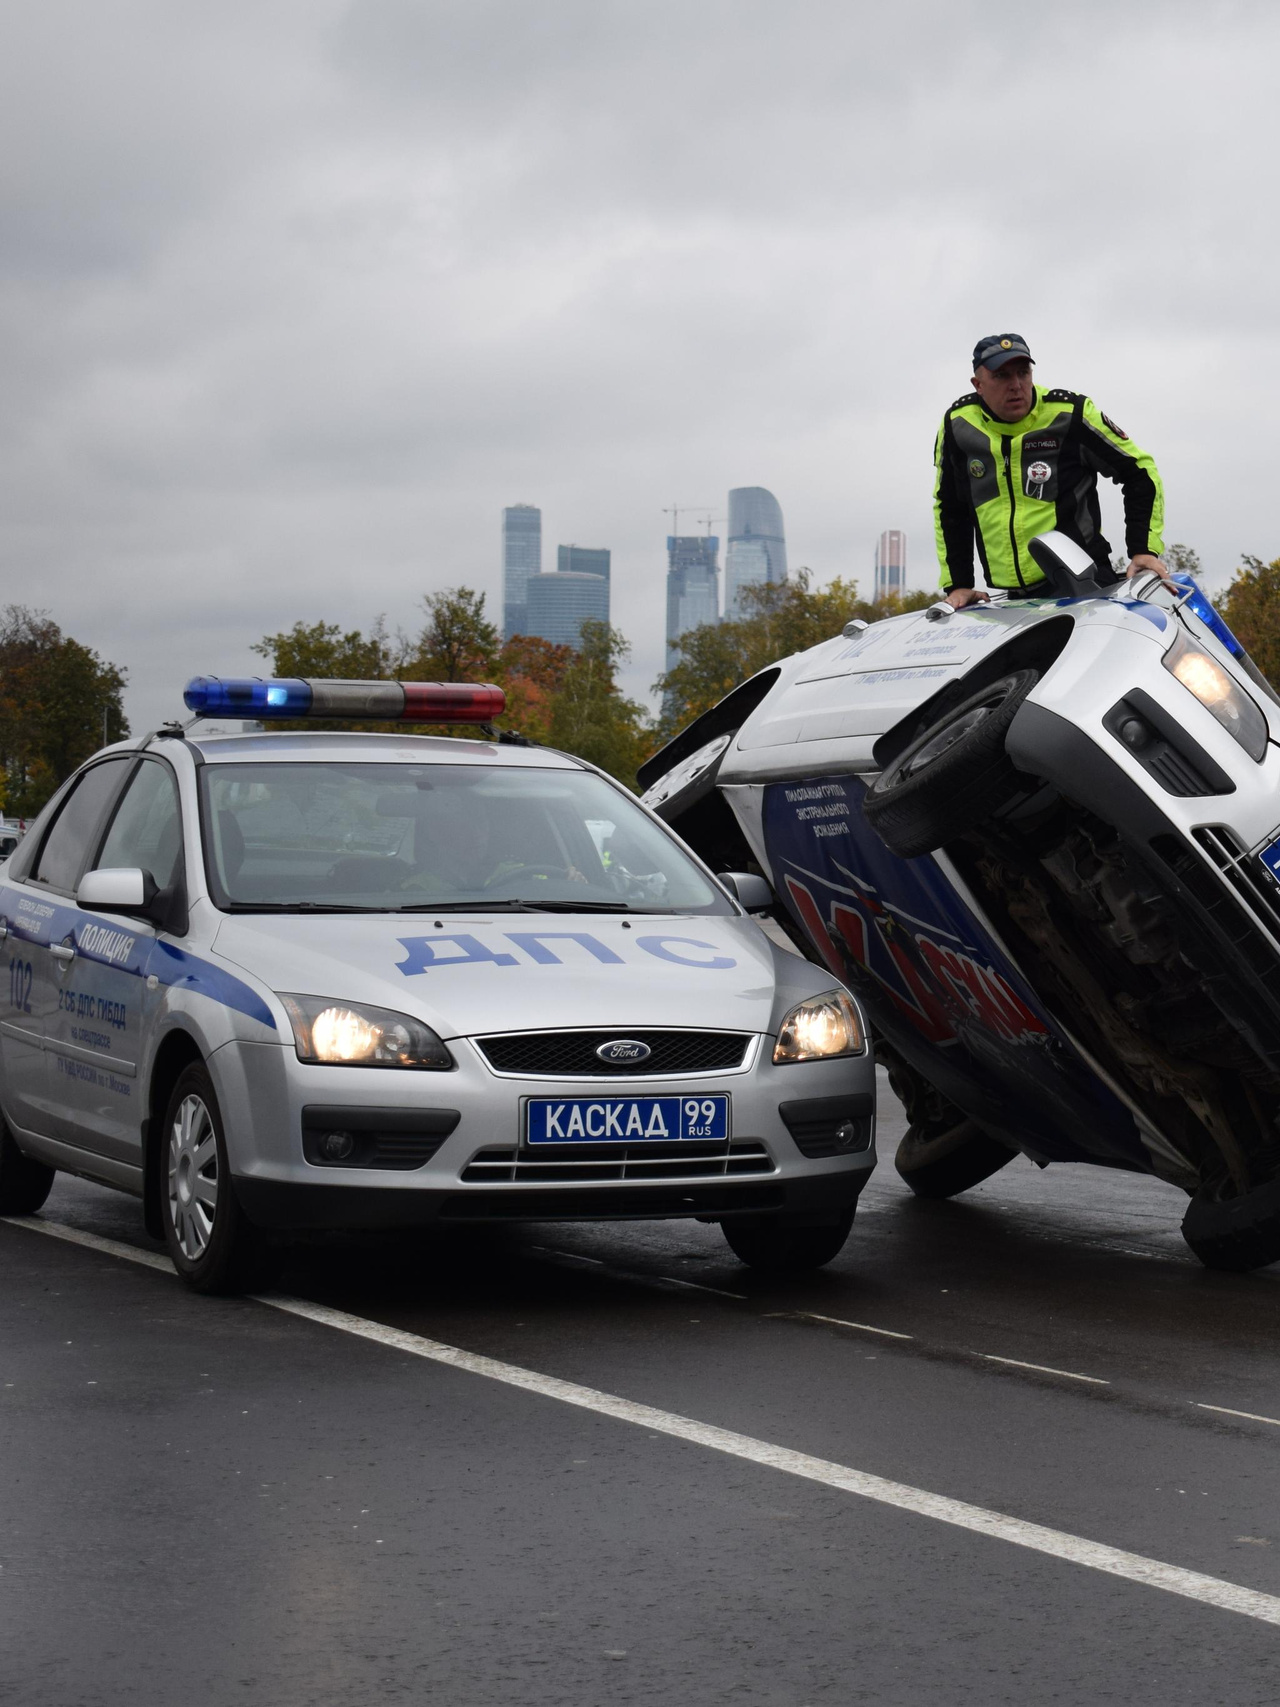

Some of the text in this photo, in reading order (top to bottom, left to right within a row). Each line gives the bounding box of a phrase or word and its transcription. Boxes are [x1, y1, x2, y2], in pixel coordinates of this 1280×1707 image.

[821, 784, 847, 798] ГРУППА
[813, 821, 850, 838] ВОЖДЕНИЯ
[79, 923, 136, 963] ПОЛИЦИЯ
[394, 932, 737, 976] ДПС
[10, 957, 32, 1013] 102
[59, 989, 126, 1031] 2 СБ ДПС ГИБДД
[546, 1100, 716, 1138] КАСКАД 99
[689, 1127, 712, 1136] RUS
